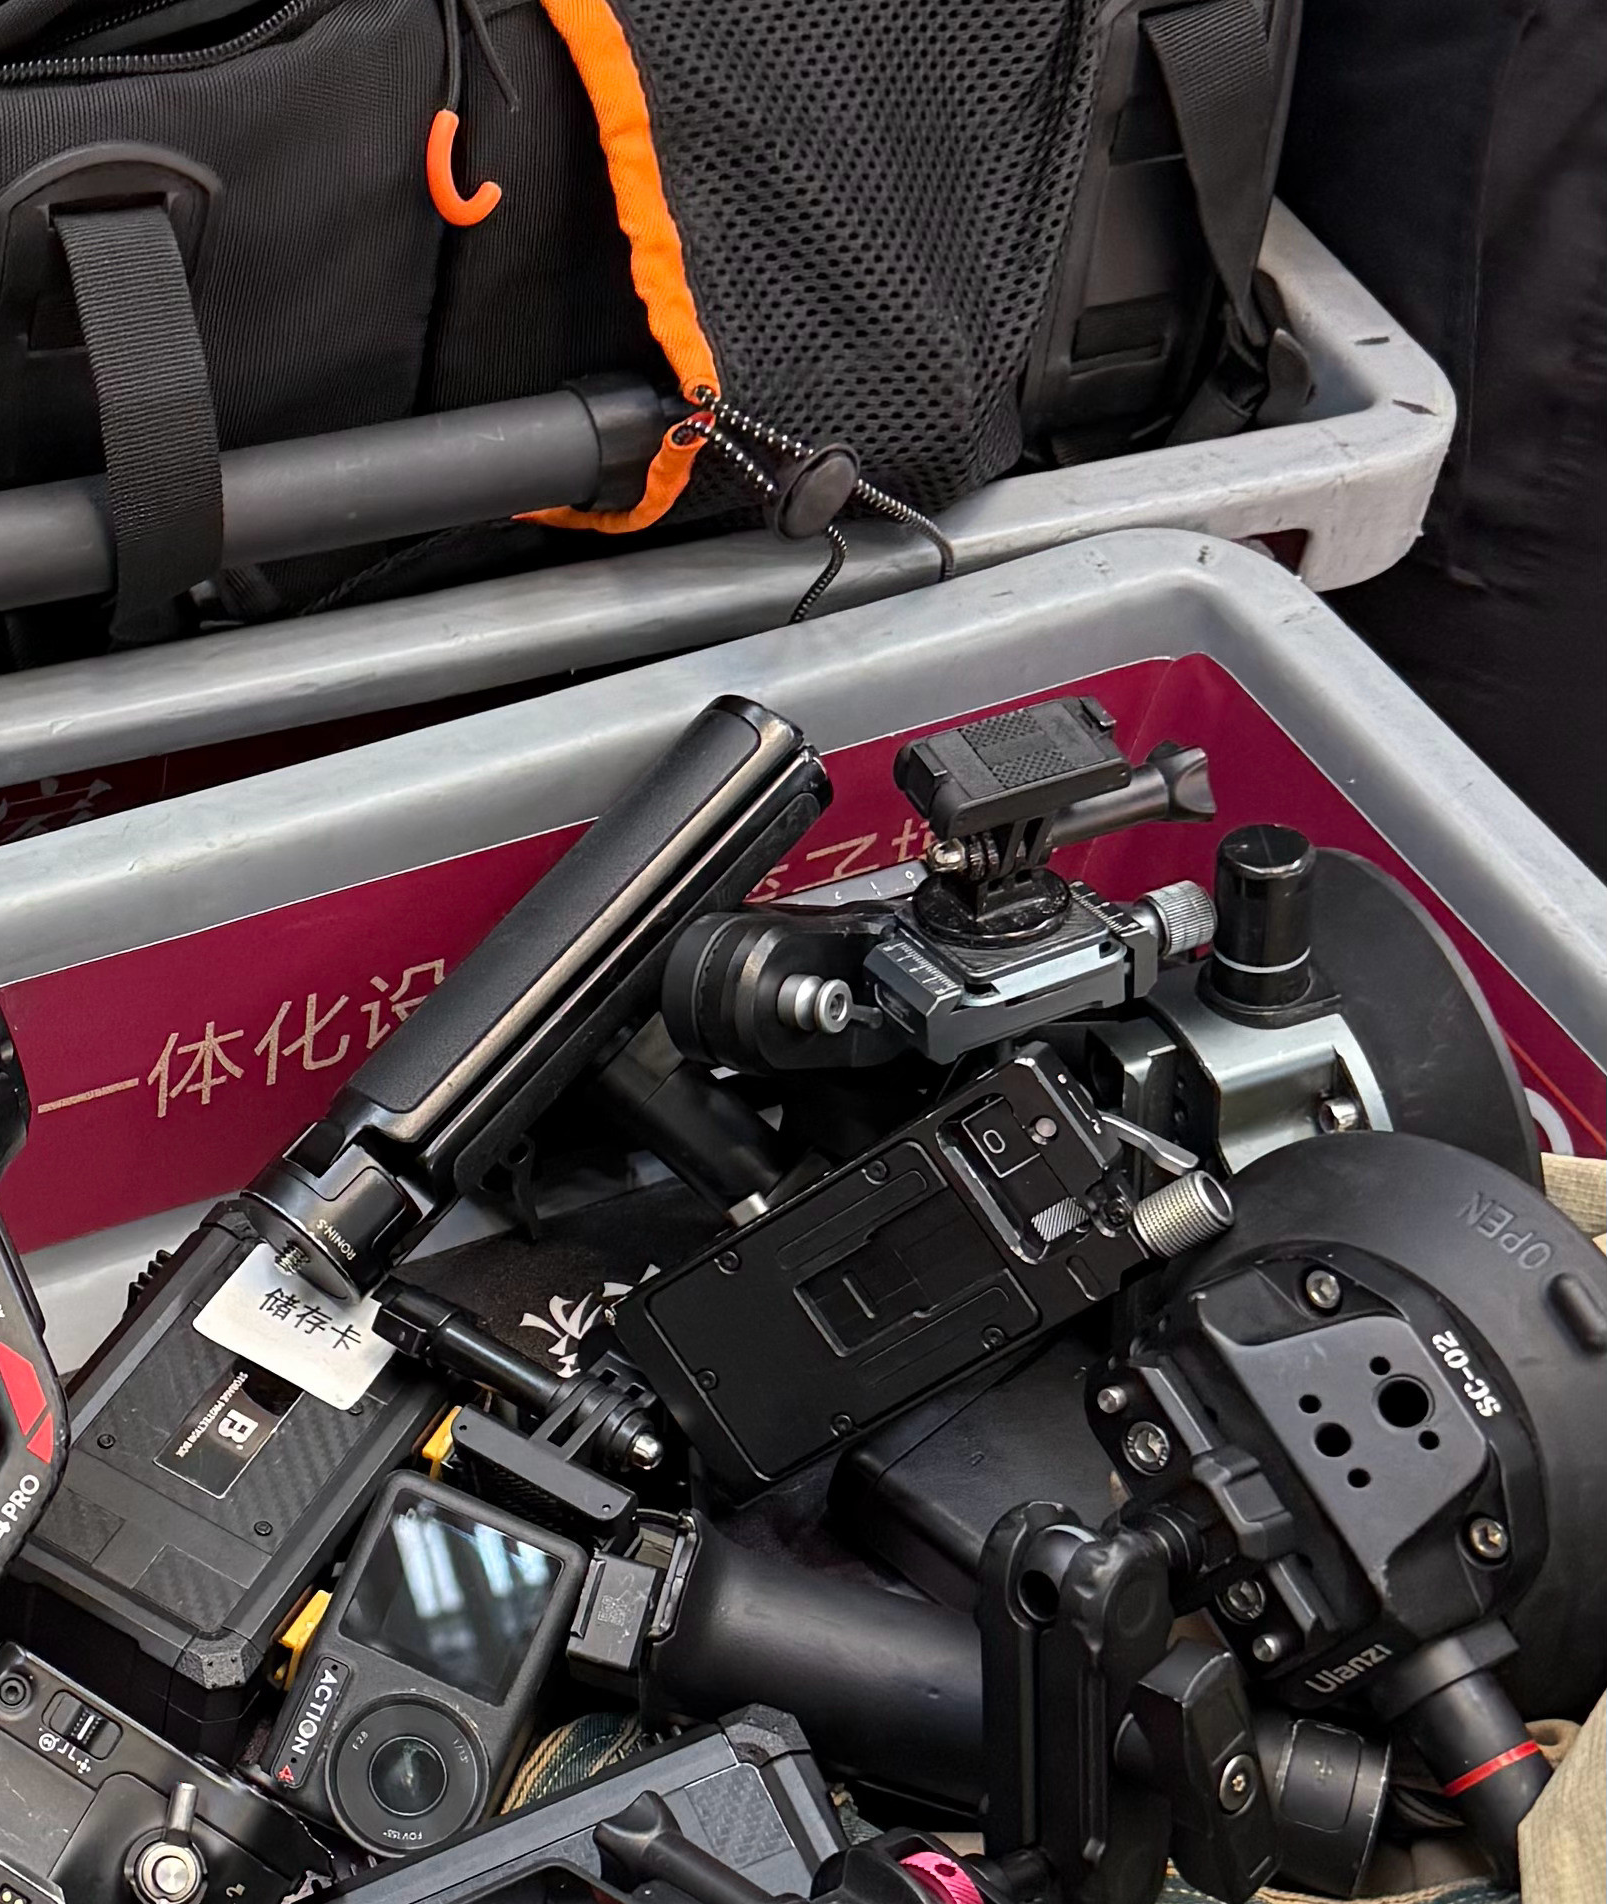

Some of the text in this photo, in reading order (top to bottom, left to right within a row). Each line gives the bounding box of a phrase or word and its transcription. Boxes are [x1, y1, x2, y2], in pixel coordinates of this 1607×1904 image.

[1455, 1191, 1552, 1270] OPEN
[258, 1287, 363, 1352] 储存卡
[1431, 1329, 1503, 1418] SC-02
[0, 1474, 41, 1522] PRO
[1305, 1644, 1393, 1693] Ulanzi
[290, 1667, 338, 1756] ACTION
[402, 1830, 423, 1841] FOV
